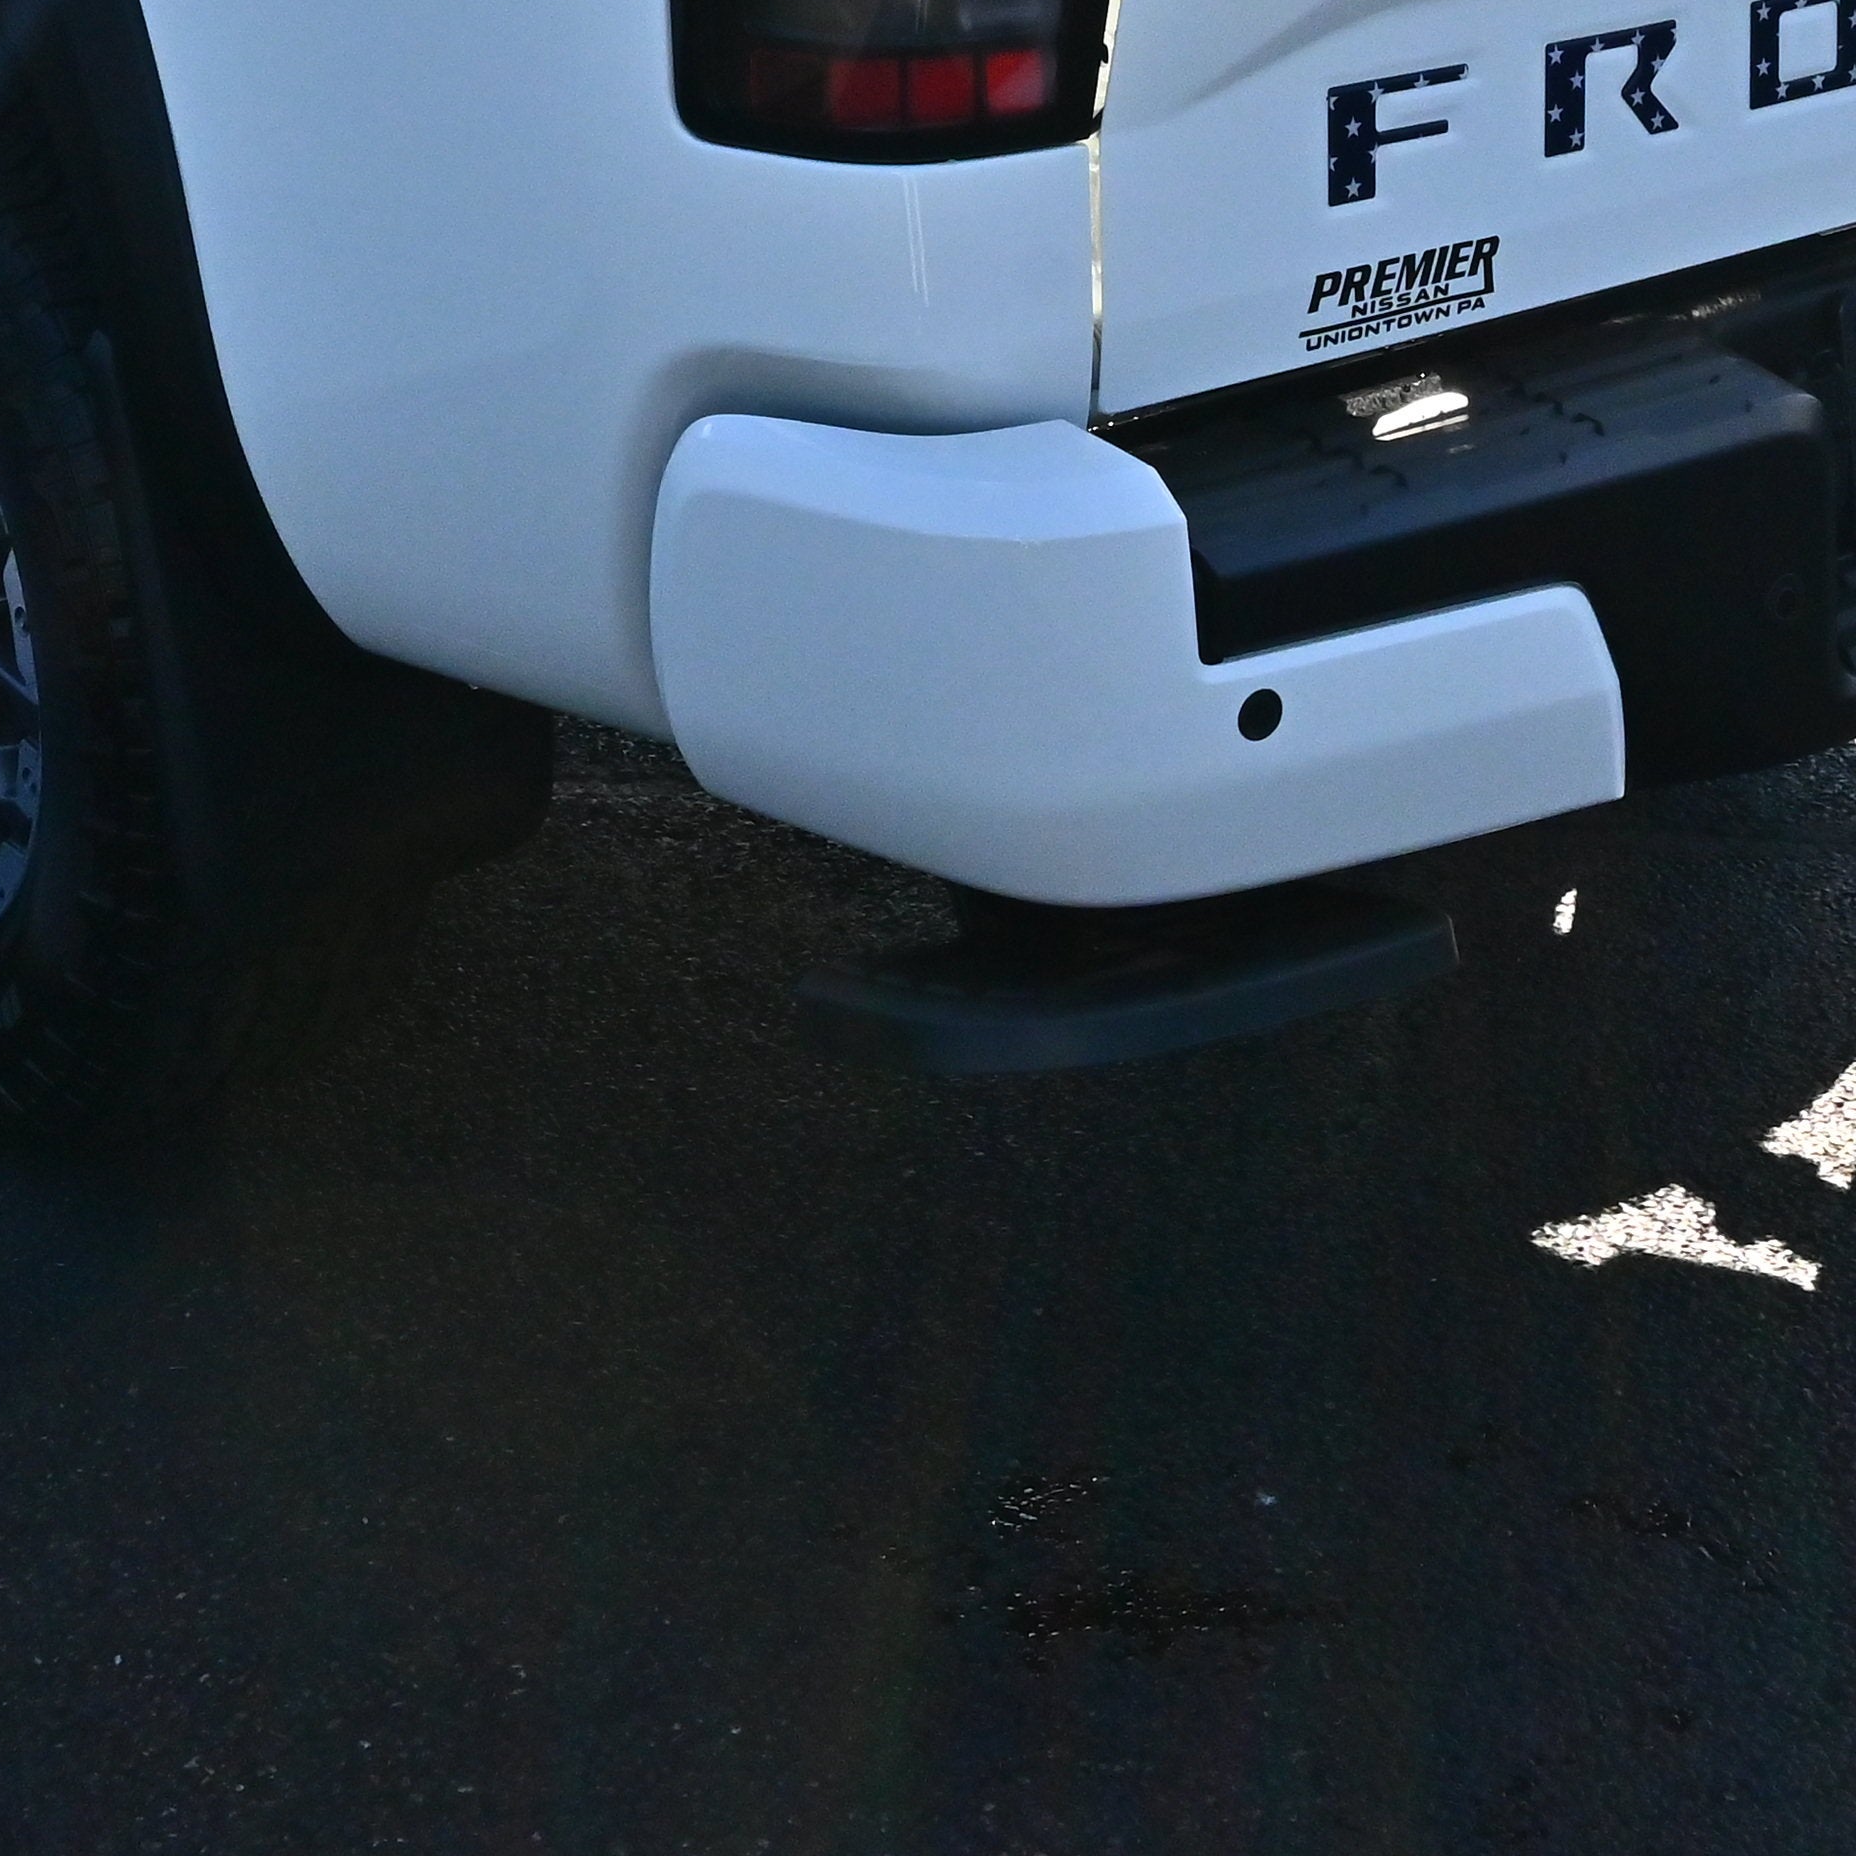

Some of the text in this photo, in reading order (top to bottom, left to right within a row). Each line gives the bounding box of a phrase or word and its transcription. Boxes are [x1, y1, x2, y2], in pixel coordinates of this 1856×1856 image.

[1307, 235, 1500, 314] PREMIER
[1351, 283, 1450, 319] NISSAN
[1305, 296, 1486, 352] UNIONTOWN PA
